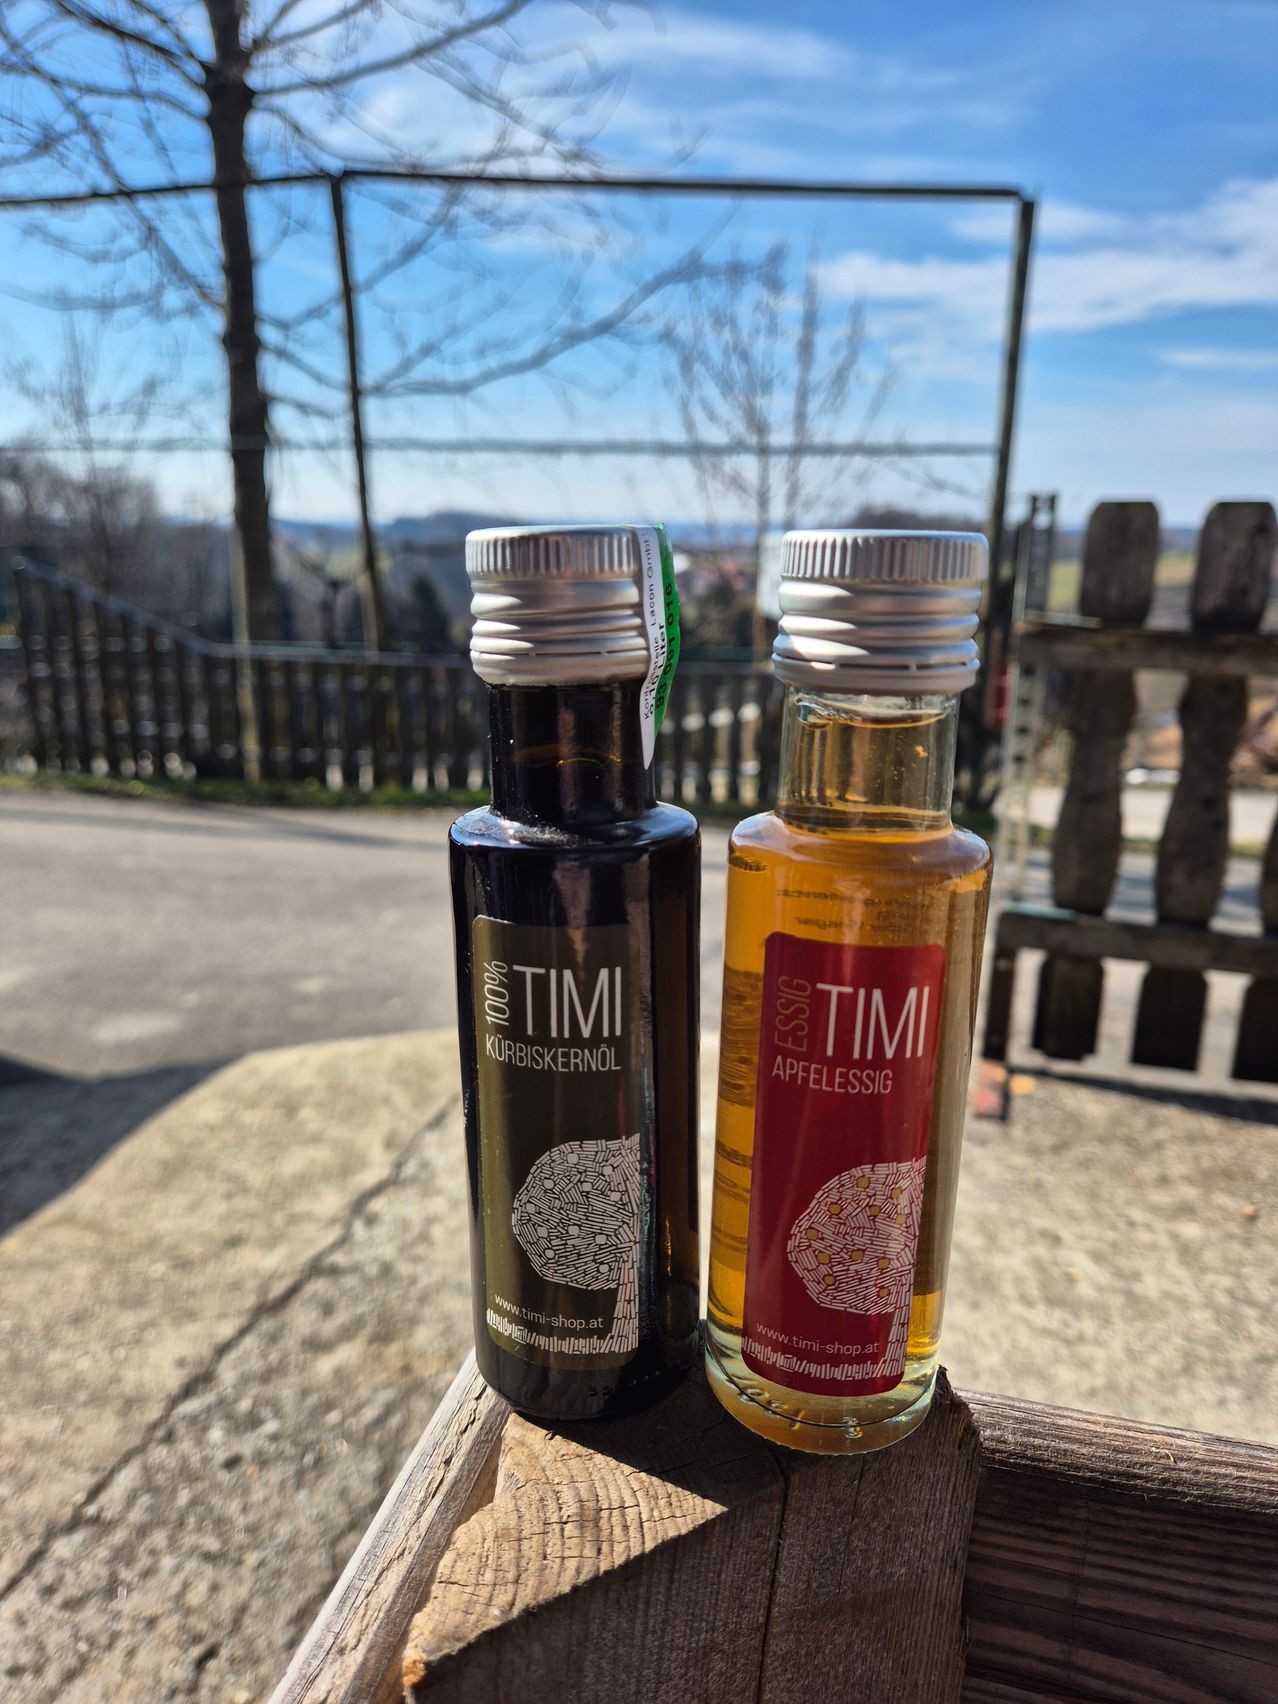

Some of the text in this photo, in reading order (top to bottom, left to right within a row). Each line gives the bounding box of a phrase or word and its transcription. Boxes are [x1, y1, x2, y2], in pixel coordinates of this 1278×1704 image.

[648, 583, 656, 627] Lacon
[655, 682, 667, 709] 93
[665, 583, 675, 627] 016
[657, 622, 666, 670] Liter
[483, 960, 510, 1026] 100%
[512, 964, 622, 1039] TIMI
[774, 975, 812, 1052] ESSIG
[815, 982, 930, 1060] TIMI
[485, 1033, 622, 1073] KÜRBISKERNÖL
[771, 1054, 893, 1095] APFELESSIG
[494, 1293, 604, 1331] www.timi-shop.at
[755, 1322, 880, 1357] www.timi-shop.at
